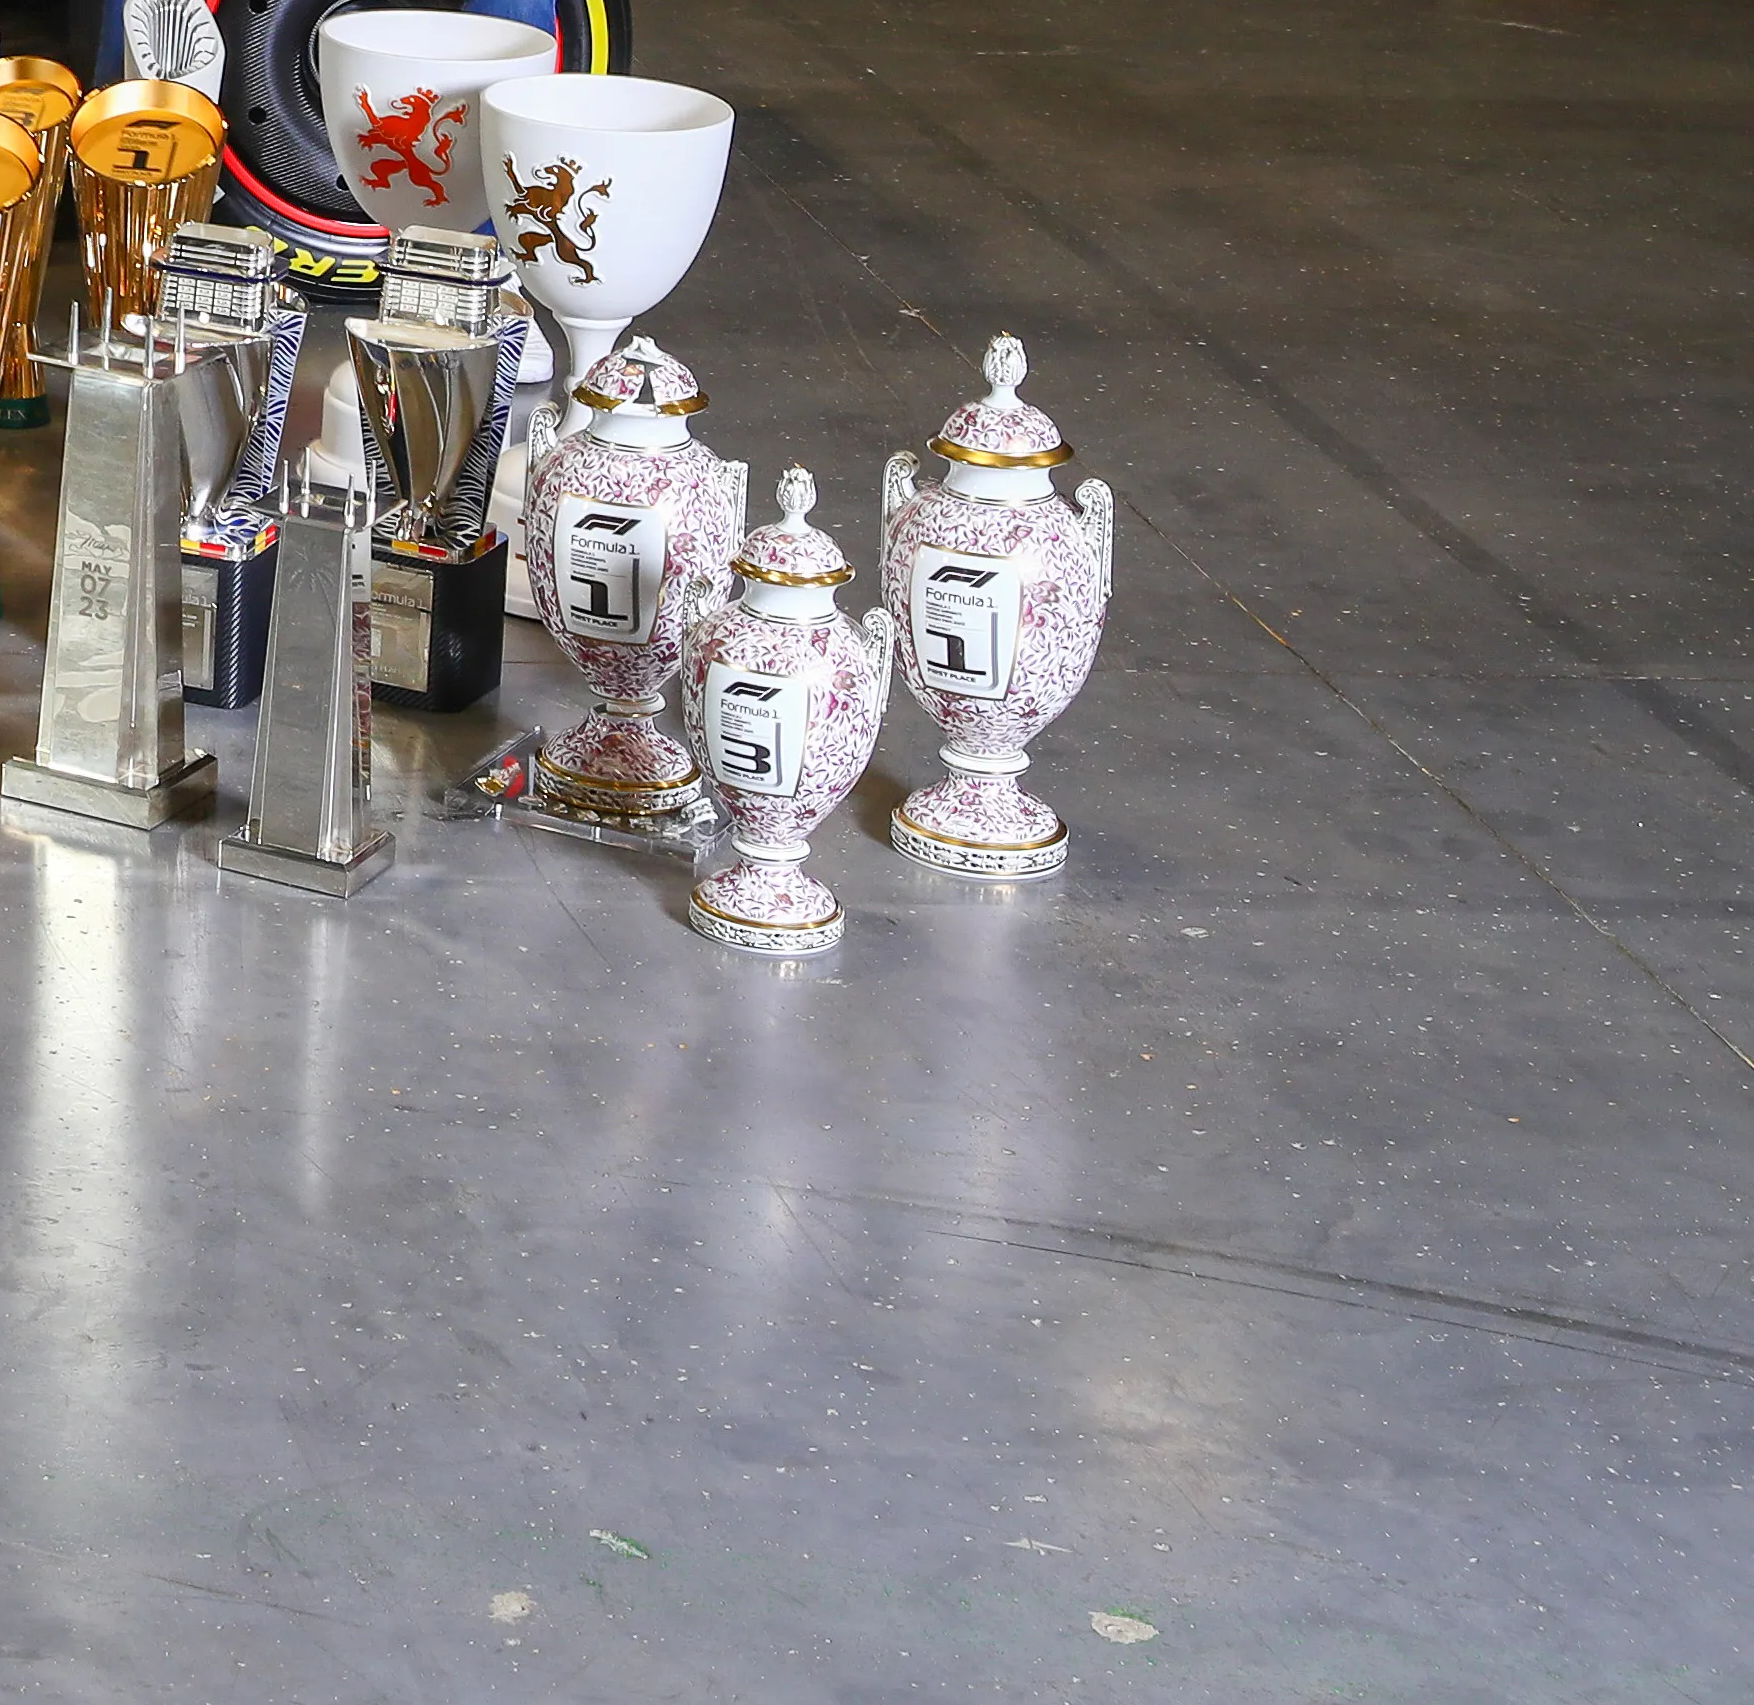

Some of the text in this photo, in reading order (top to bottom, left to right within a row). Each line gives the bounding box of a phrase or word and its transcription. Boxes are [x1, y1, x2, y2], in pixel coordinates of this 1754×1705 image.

[573, 512, 643, 536] F1
[570, 534, 628, 555] Formula
[81, 560, 113, 577] MAY
[927, 565, 1000, 589] F1
[79, 573, 112, 595] 07
[570, 574, 629, 621] 1
[925, 586, 984, 608] Formula
[78, 596, 110, 622] 23
[592, 616, 618, 628] PLACE
[925, 628, 987, 676] 1
[949, 672, 977, 684] PLACE
[722, 681, 783, 702] F1
[720, 698, 770, 719] Formula
[720, 733, 772, 774] 3
